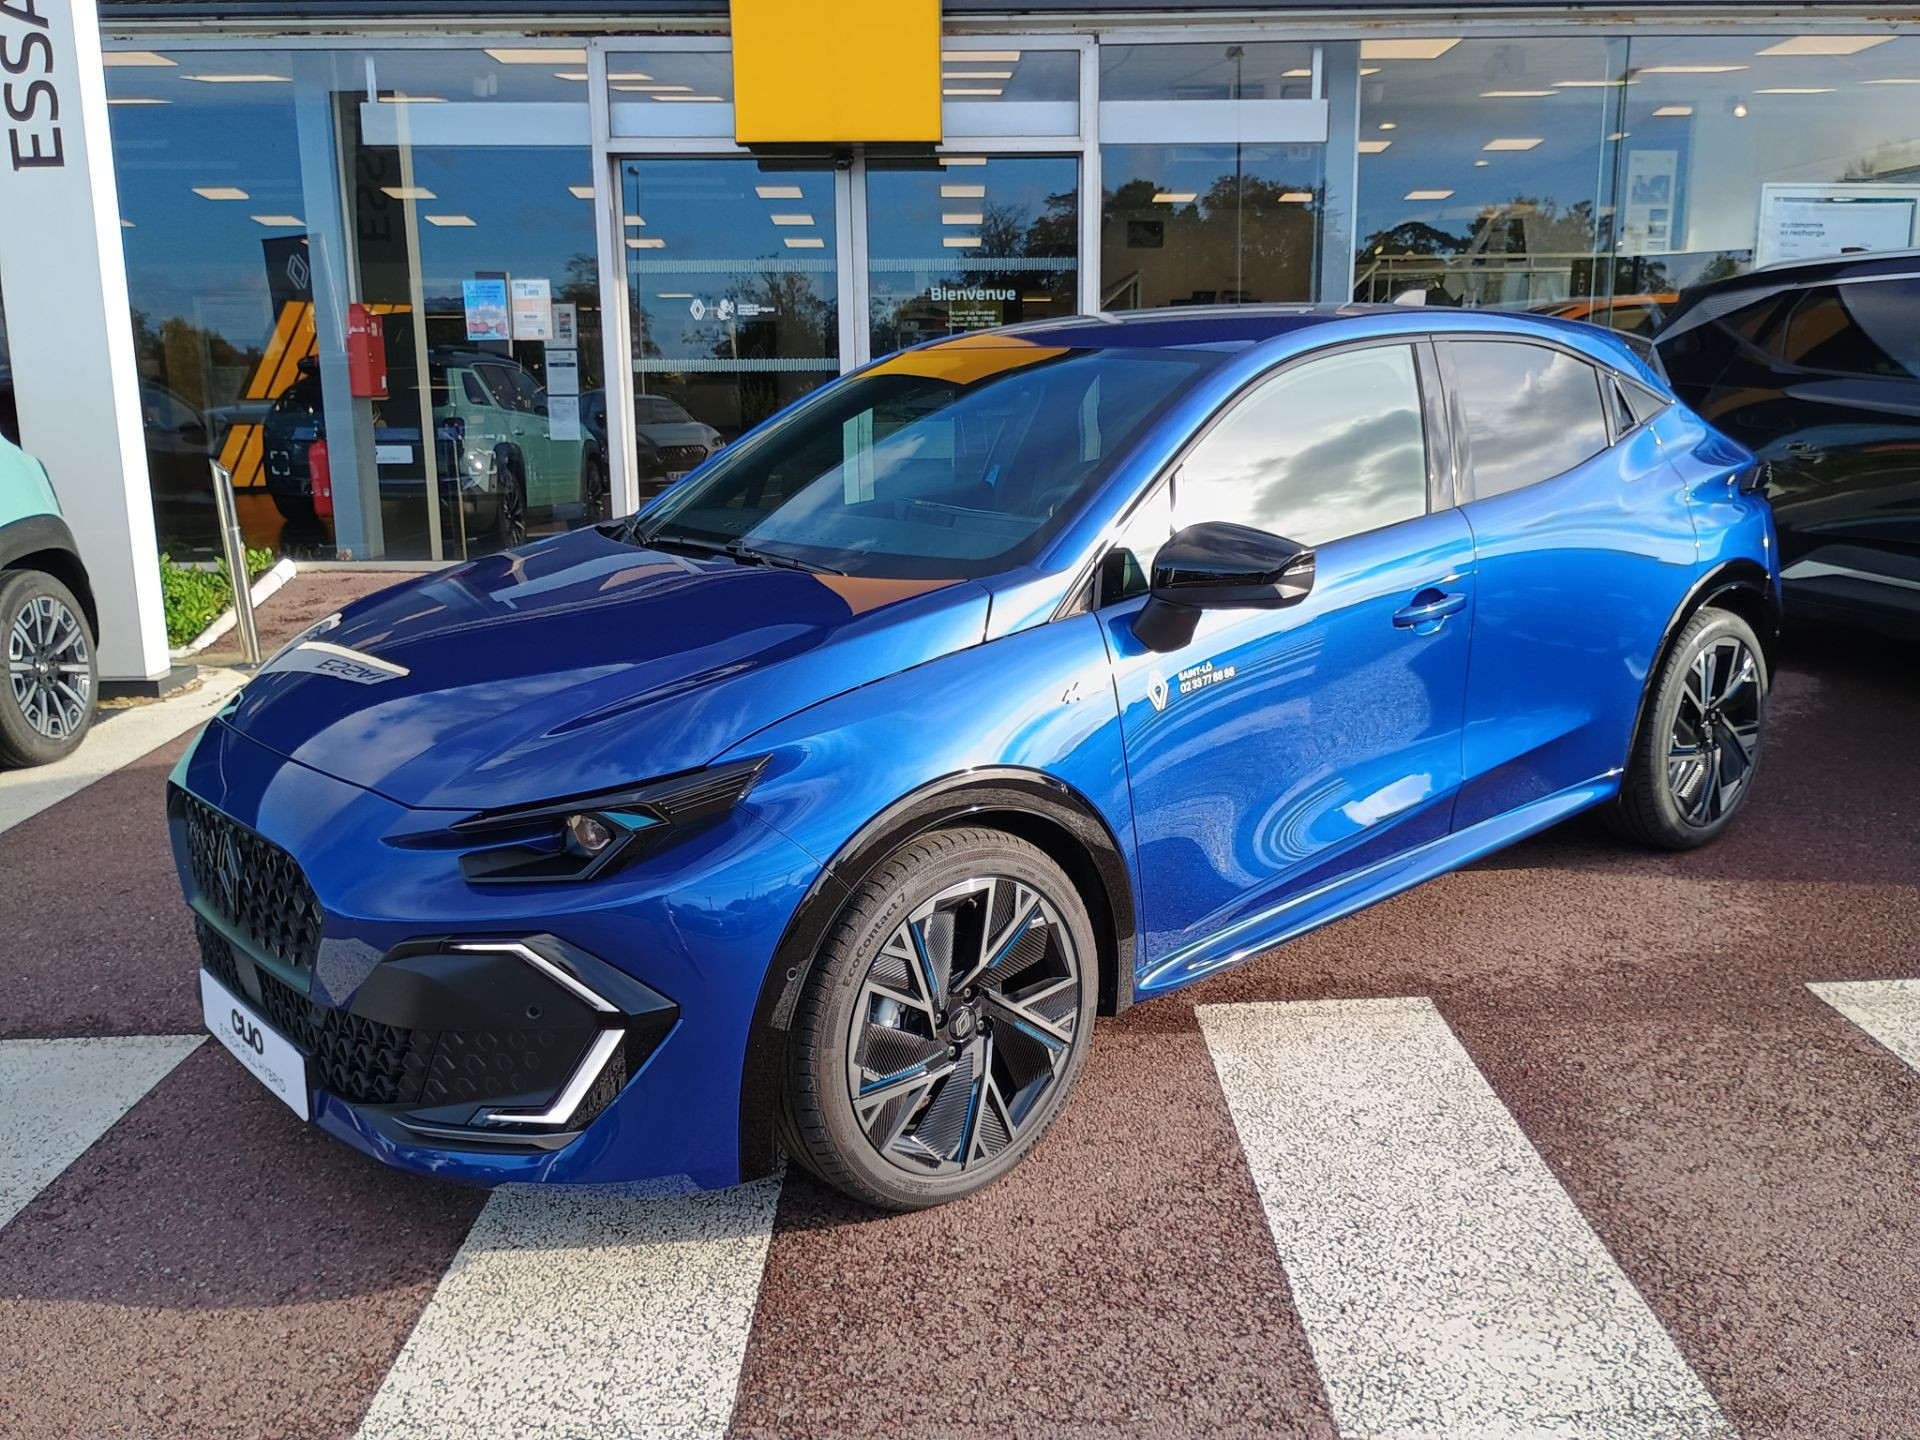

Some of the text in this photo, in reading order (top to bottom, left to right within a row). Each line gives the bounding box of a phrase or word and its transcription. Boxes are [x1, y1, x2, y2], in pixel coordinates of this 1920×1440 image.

[930, 285, 1016, 301] Bienvenue
[1178, 661, 1213, 681] SAINT-LÔ
[1180, 681, 1193, 694] 02
[1202, 673, 1212, 686] 77
[1212, 670, 1224, 683] 88
[1223, 666, 1235, 679] 88
[841, 901, 899, 988] EcoContact
